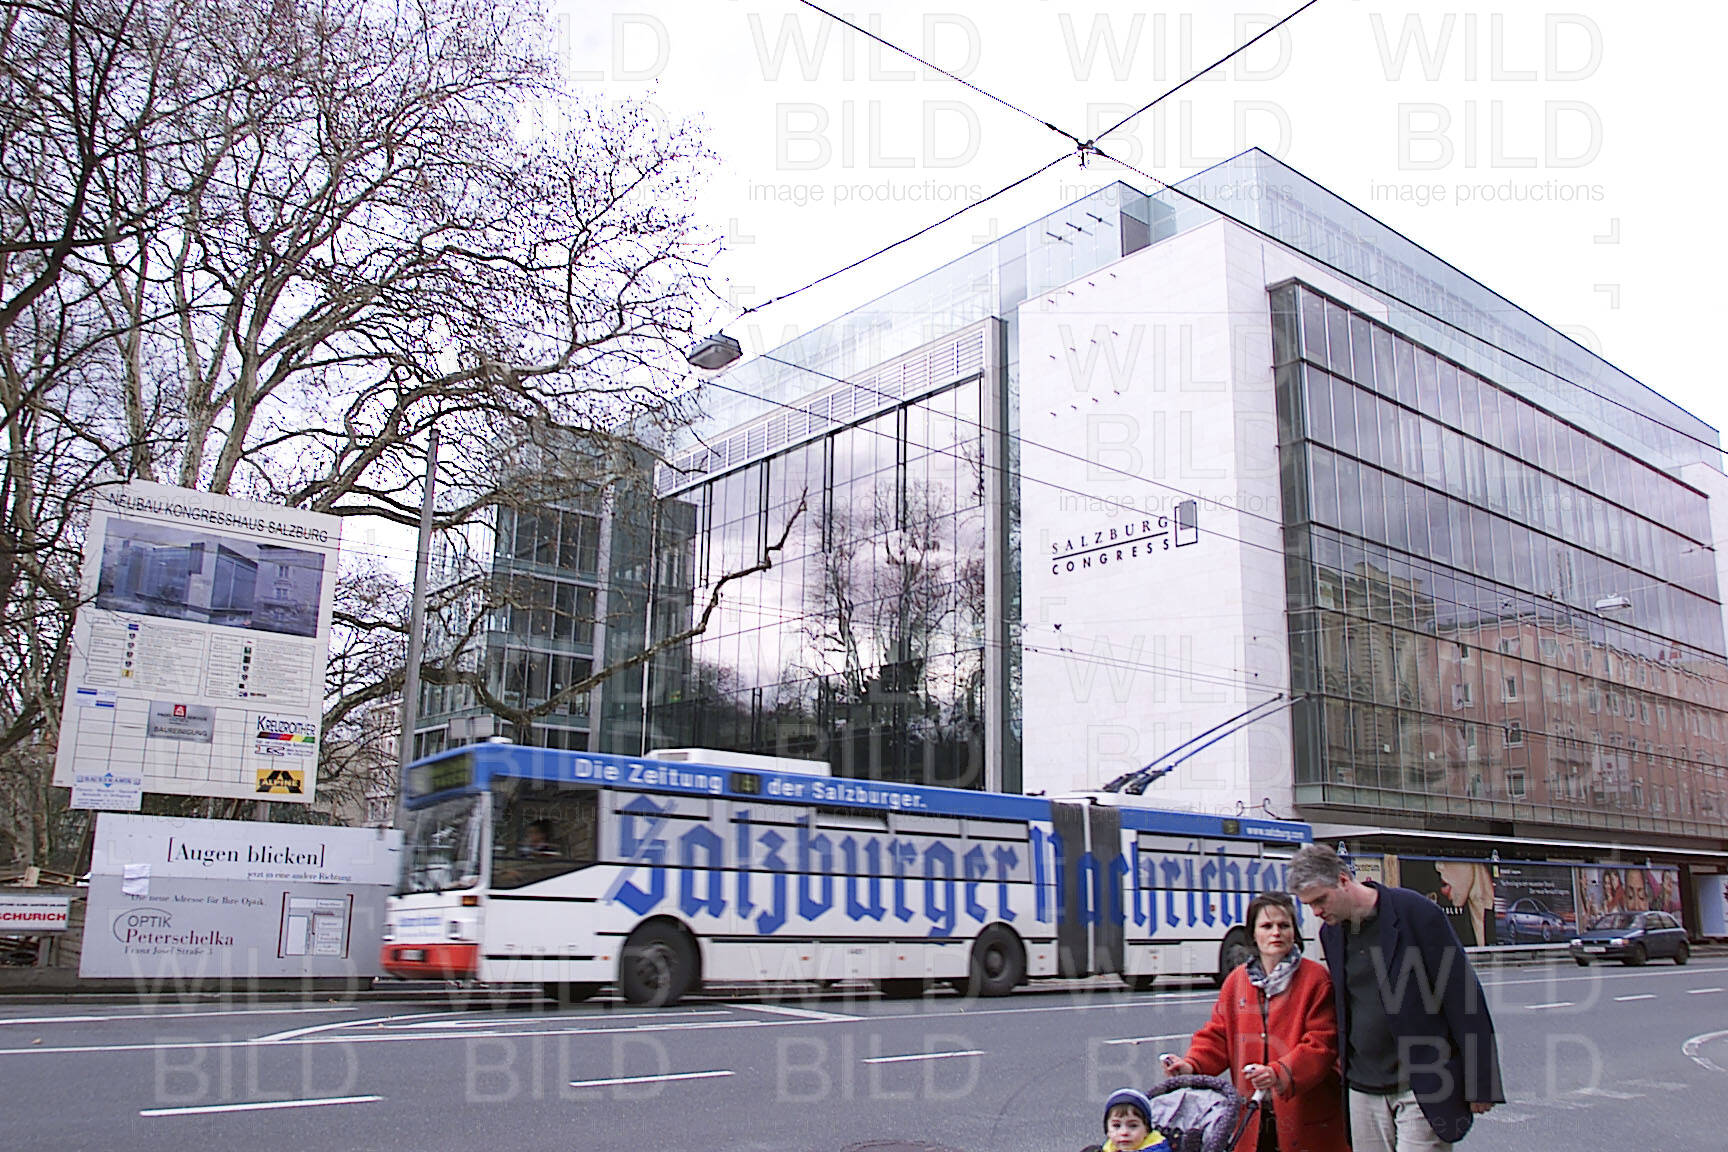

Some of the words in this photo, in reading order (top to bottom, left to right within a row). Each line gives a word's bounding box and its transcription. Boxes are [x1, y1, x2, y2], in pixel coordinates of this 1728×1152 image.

[110, 493, 162, 514] NEUBAU
[164, 503, 265, 532] KONGRESSHAUS
[268, 521, 328, 543] SALZBURG
[1052, 515, 1169, 555] SALZBURG
[1052, 538, 1169, 575] CONGRESS
[574, 757, 620, 782] Die
[628, 762, 724, 795] Zeitung
[767, 777, 805, 799] der
[811, 782, 926, 811] Salzburger.
[167, 837, 239, 867] [Augen
[247, 844, 326, 868] blicken]
[608, 795, 1021, 945] Salzburger
[126, 928, 234, 946] Peterschelka
[127, 915, 172, 928] OPTIK
